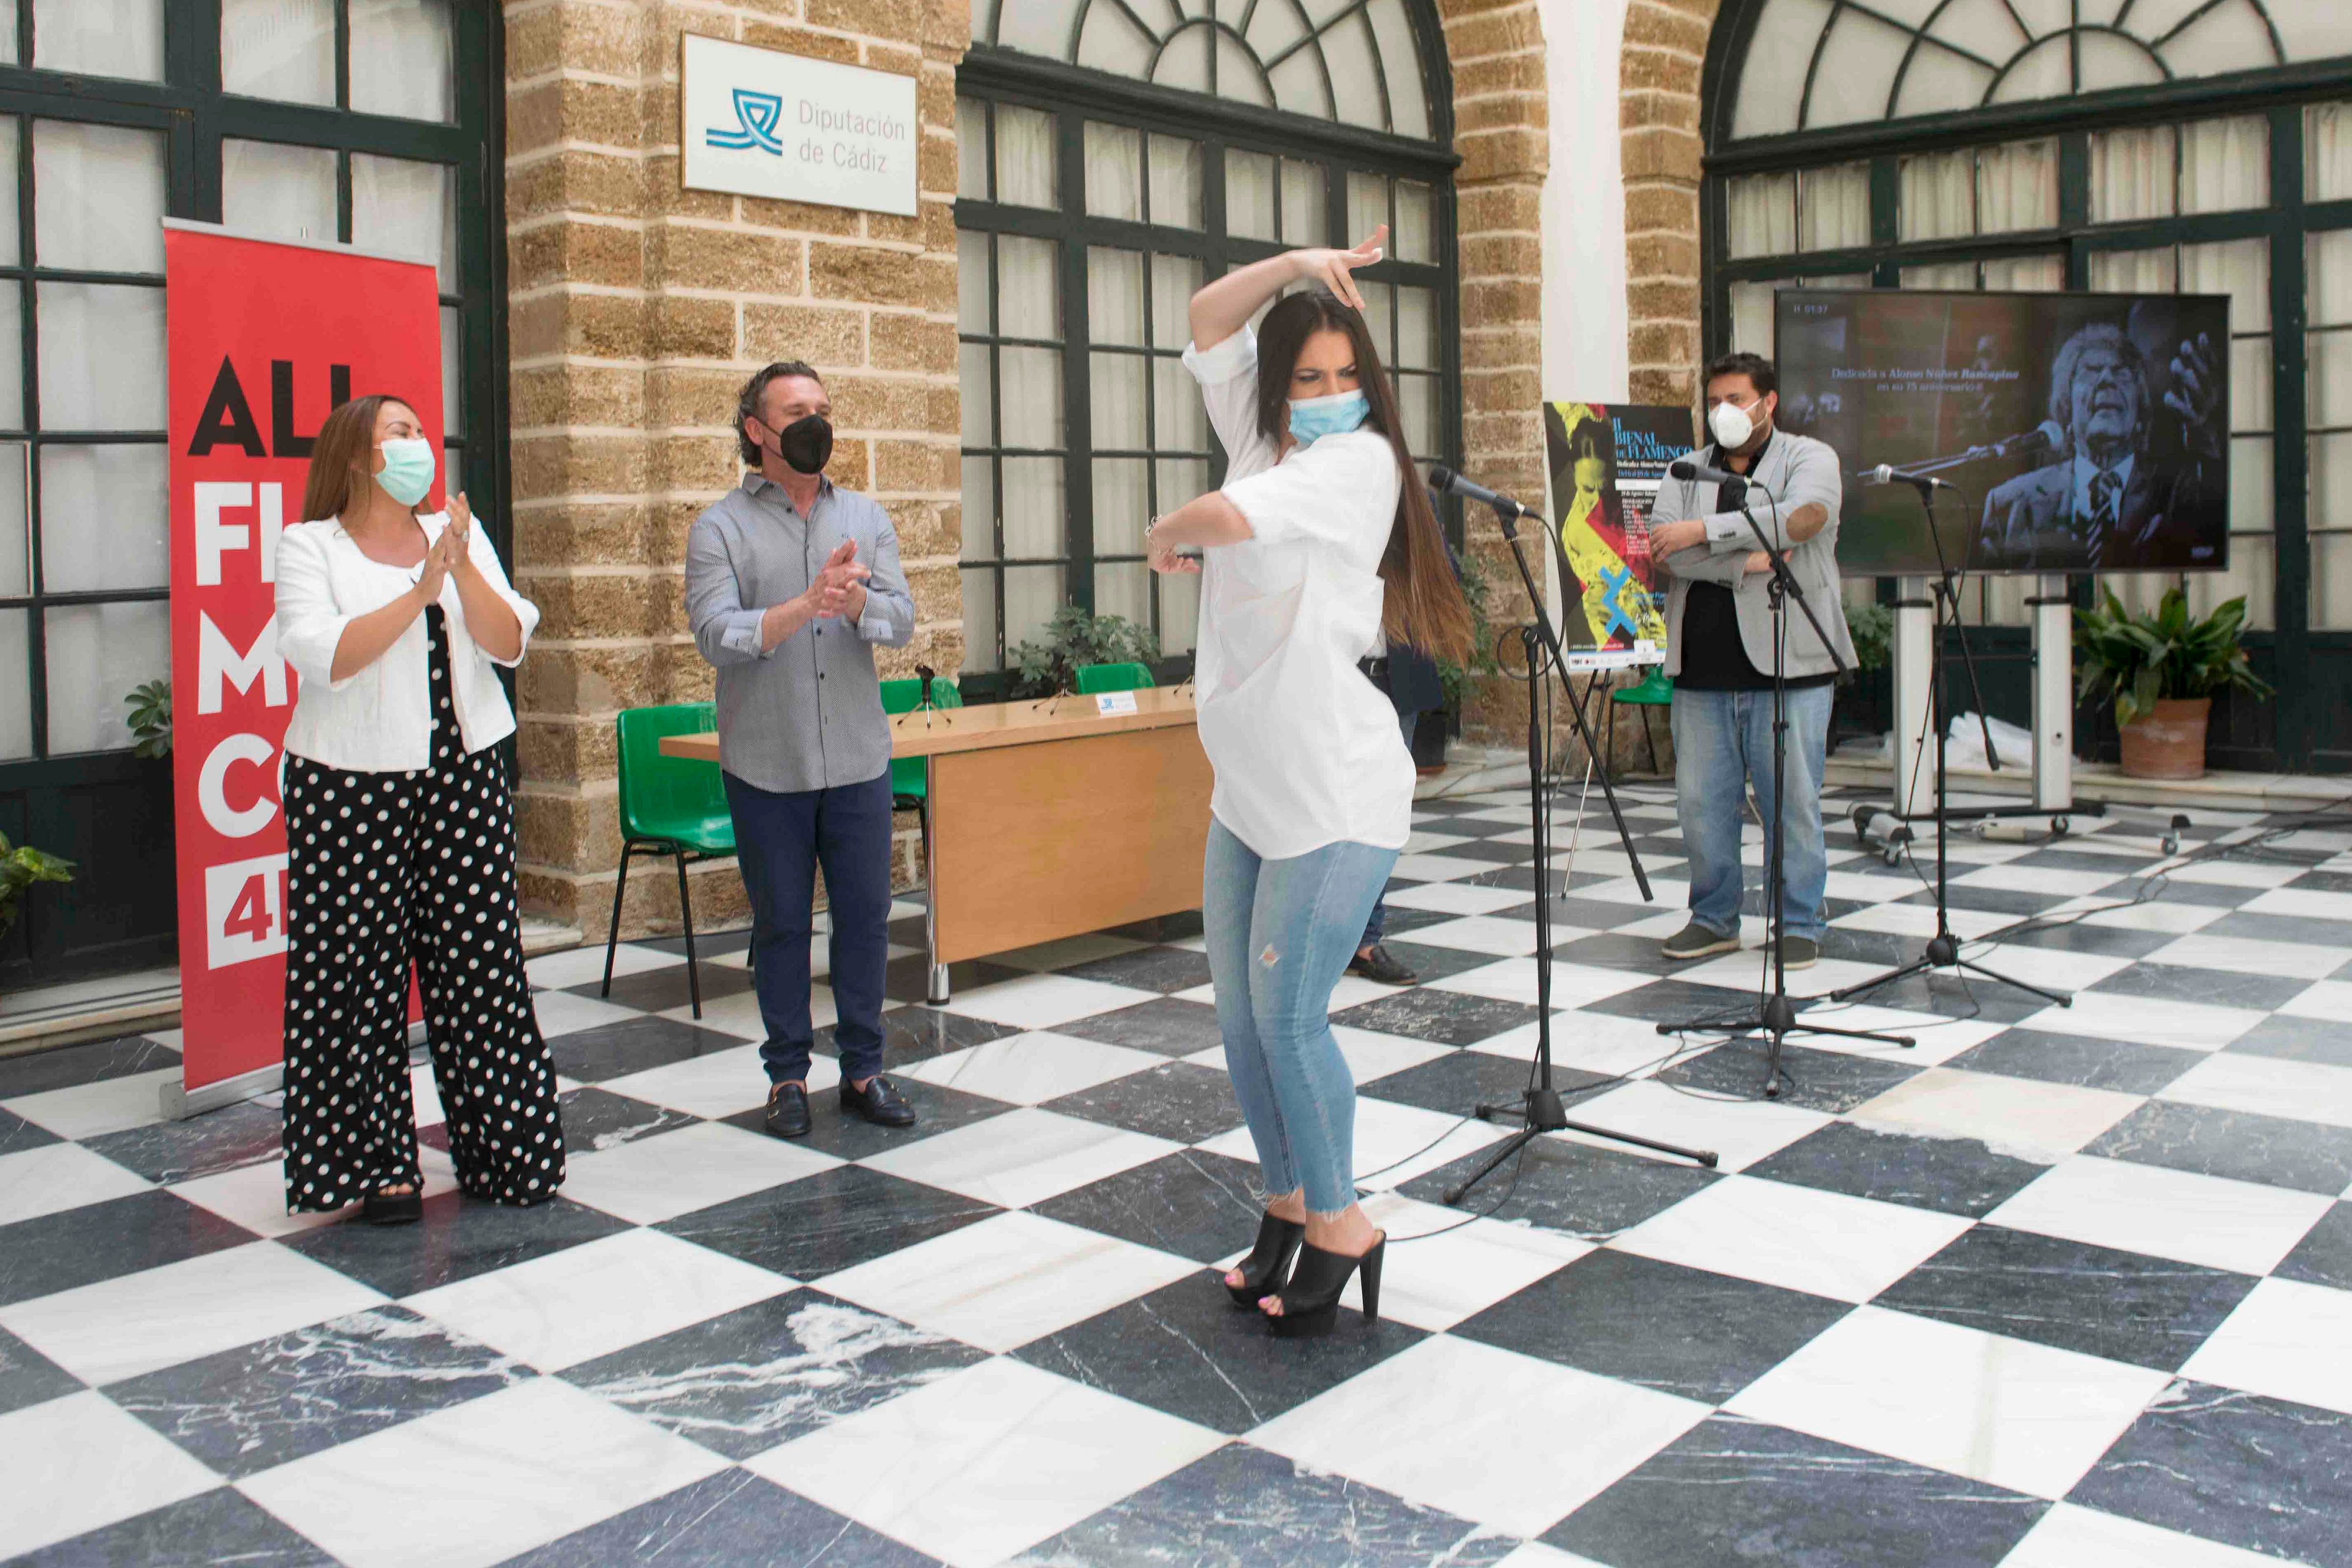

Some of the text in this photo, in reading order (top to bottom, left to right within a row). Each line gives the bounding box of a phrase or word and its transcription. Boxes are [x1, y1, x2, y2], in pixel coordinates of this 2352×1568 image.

[799, 98, 905, 140] Diputación
[800, 138, 887, 173] de Cádiz
[1614, 430, 1660, 446] BIENAL
[198, 608, 305, 715] M
[198, 733, 286, 838] C
[223, 869, 289, 943] 4
